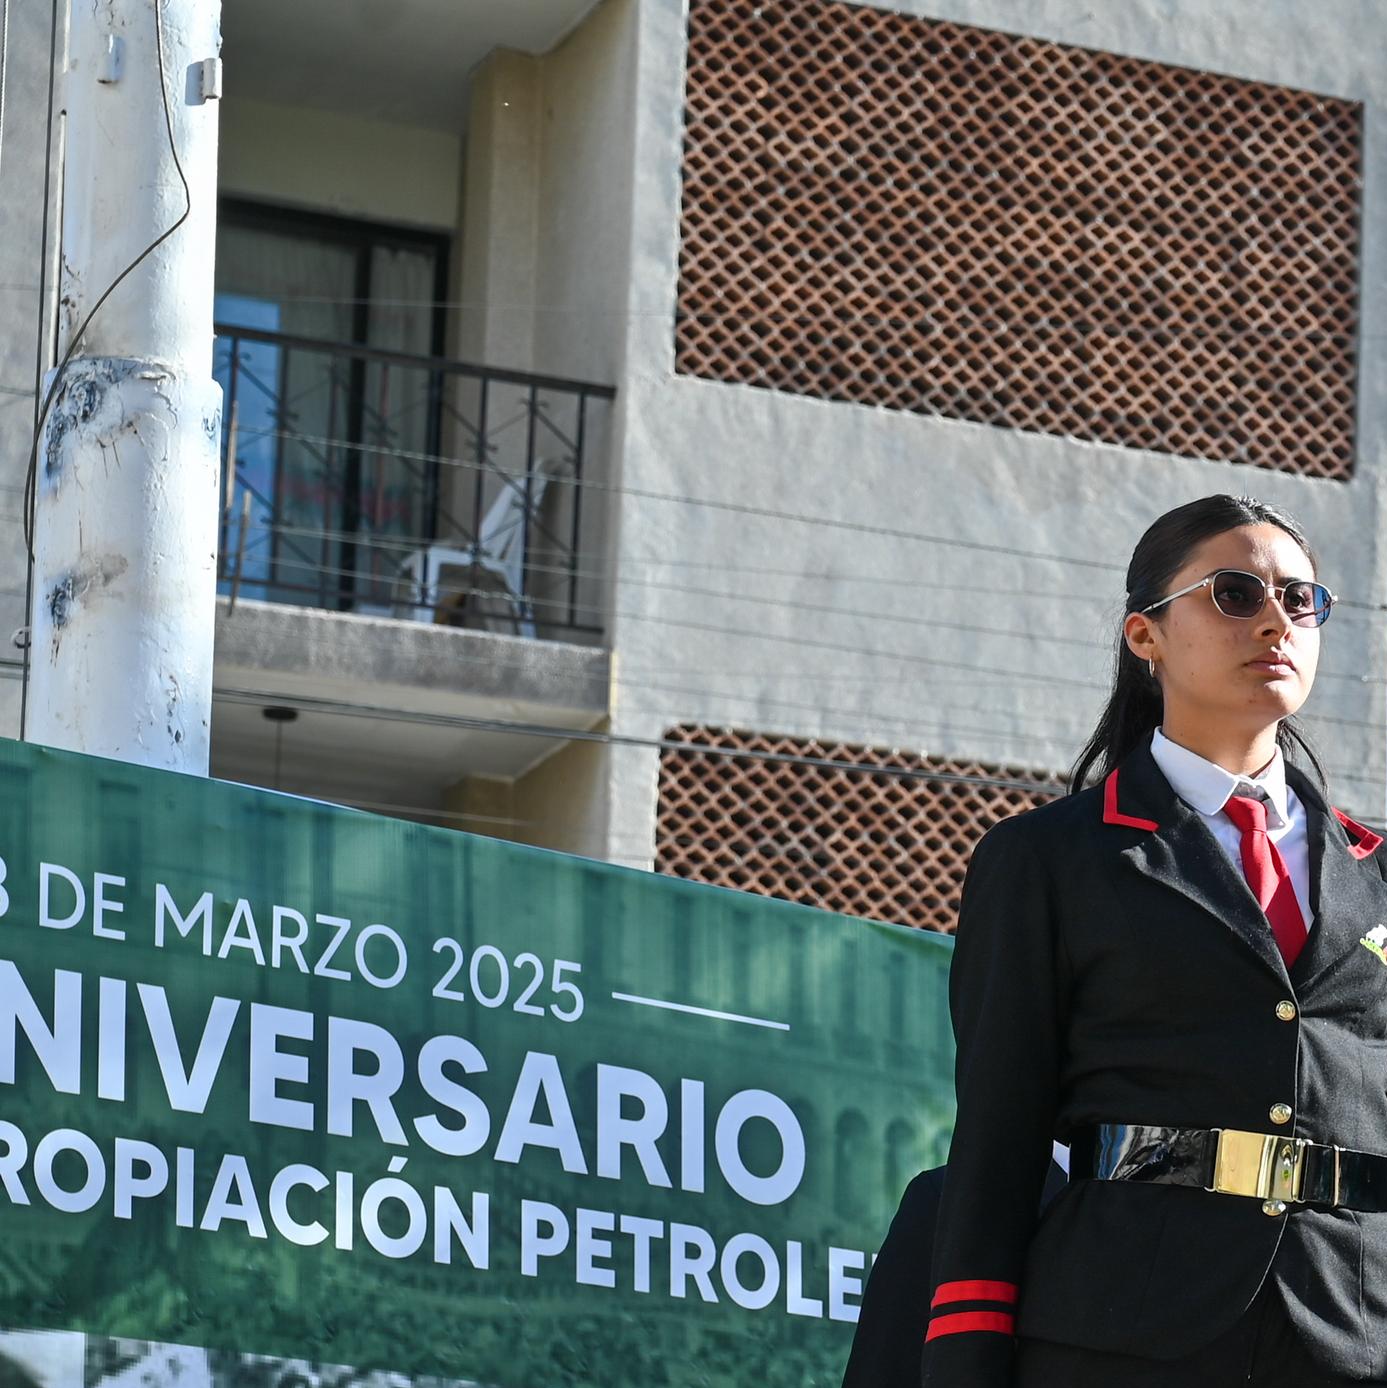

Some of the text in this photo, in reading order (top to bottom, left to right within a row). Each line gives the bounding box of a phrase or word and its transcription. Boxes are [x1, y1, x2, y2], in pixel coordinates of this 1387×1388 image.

[39, 861, 126, 941] DE
[154, 883, 408, 990] MARZO
[432, 936, 585, 1023] 2025
[0, 959, 806, 1206] NIVERSARIO
[522, 1200, 878, 1324] PETROLE
